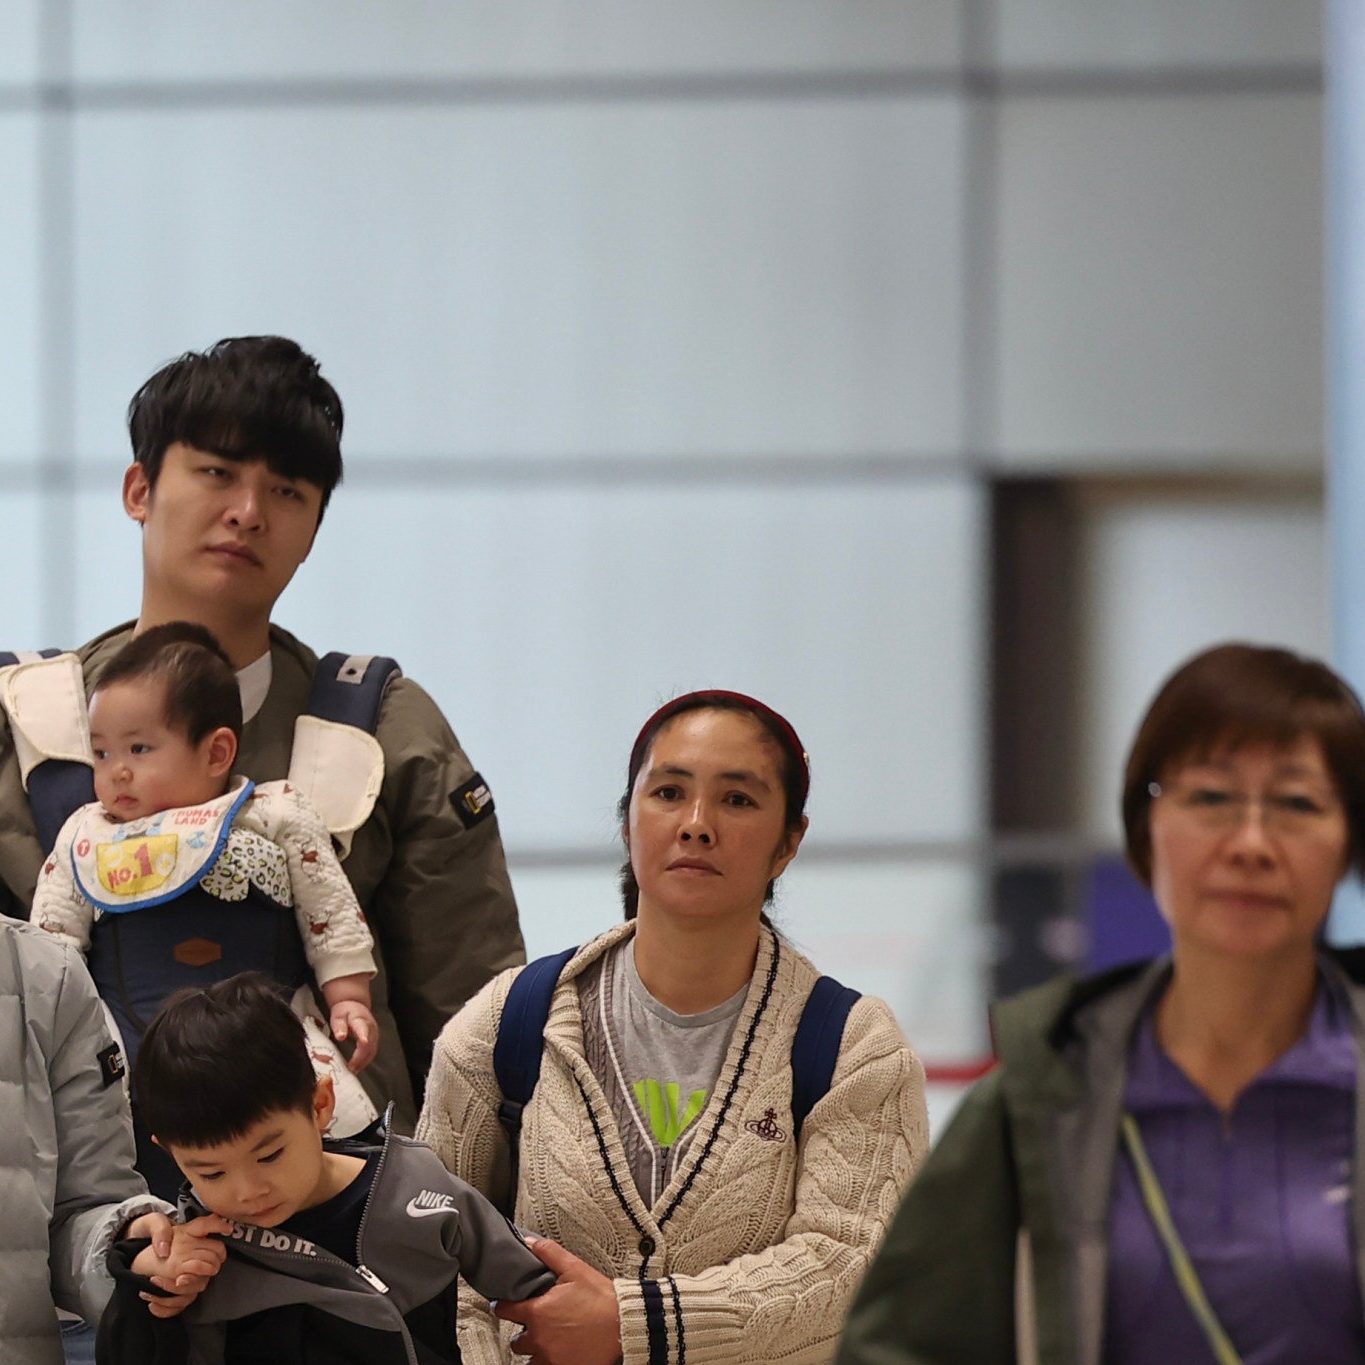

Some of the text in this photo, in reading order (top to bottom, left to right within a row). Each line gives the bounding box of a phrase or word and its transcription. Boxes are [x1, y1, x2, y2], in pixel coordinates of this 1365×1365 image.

[174, 816, 208, 826] LAND
[415, 1189, 454, 1209] NIKE
[259, 1229, 291, 1252] DO
